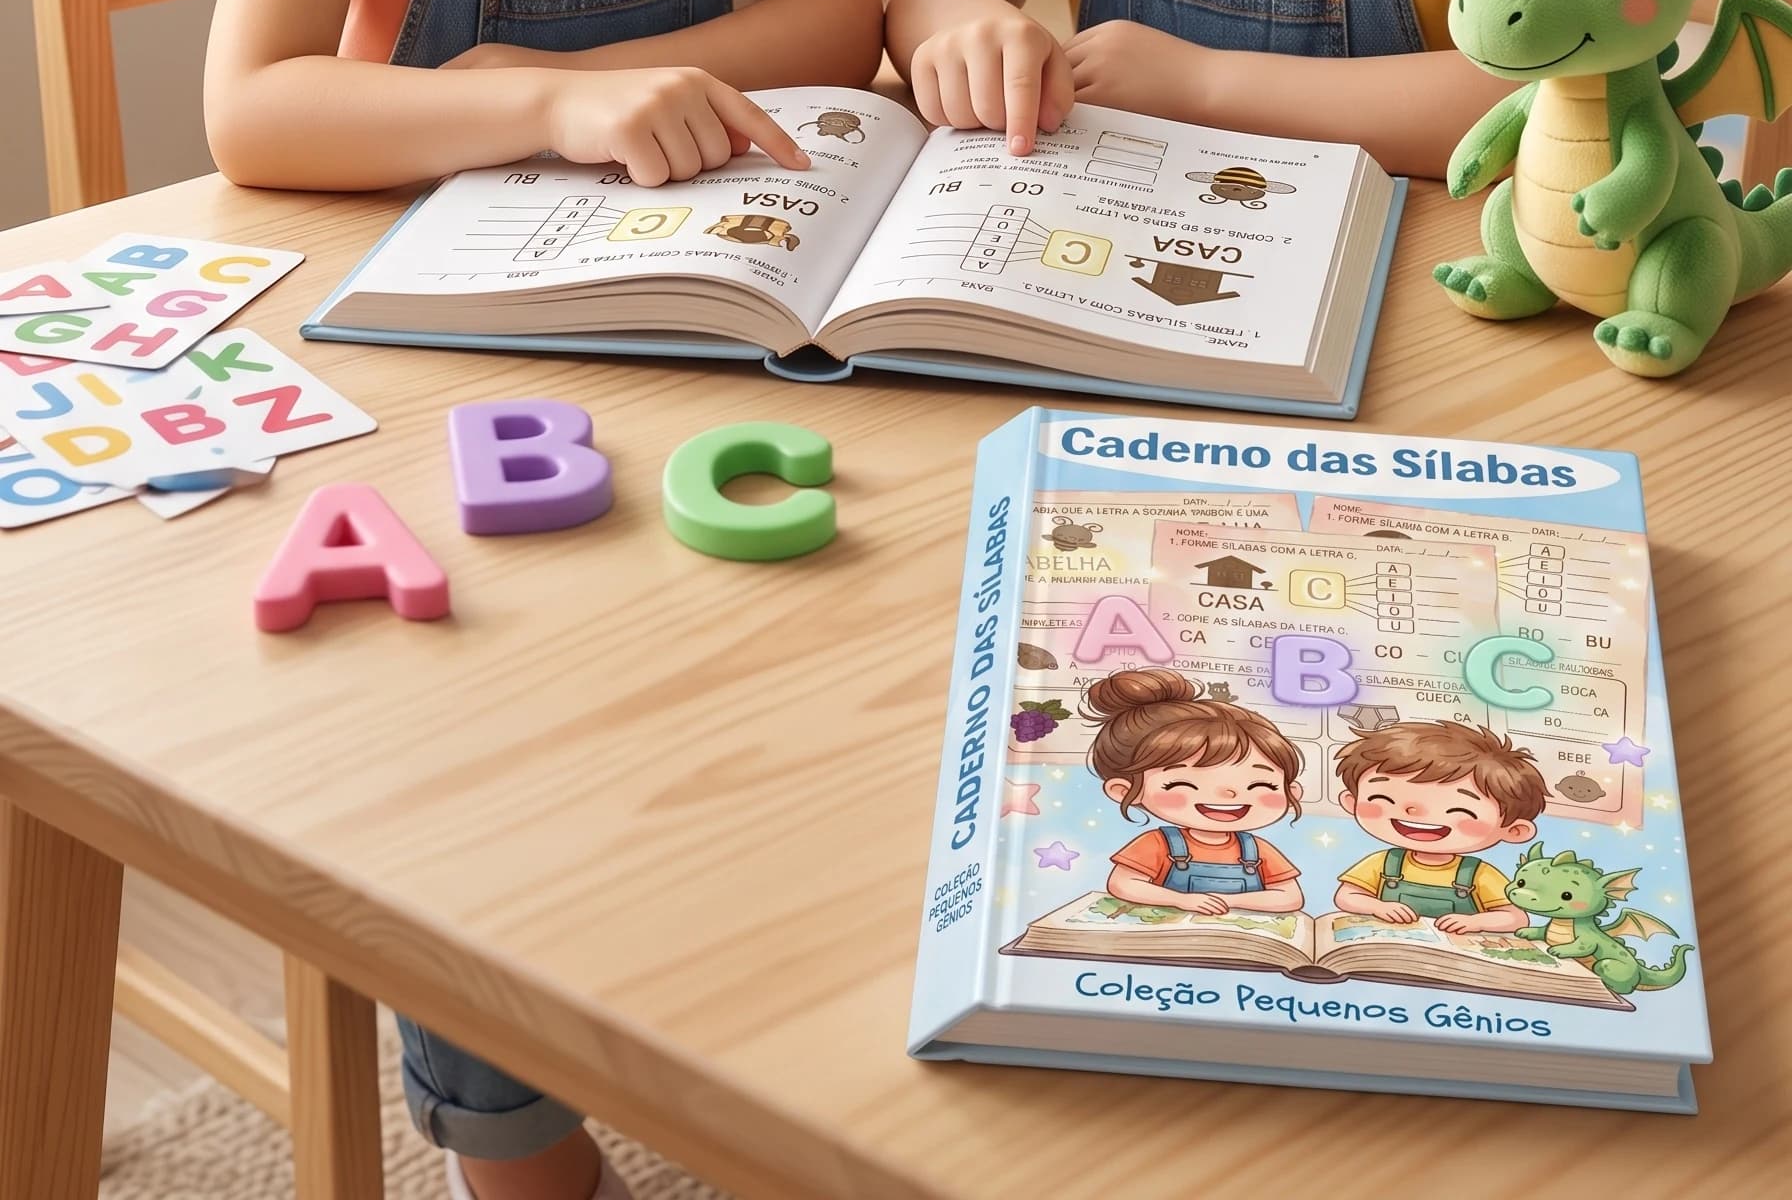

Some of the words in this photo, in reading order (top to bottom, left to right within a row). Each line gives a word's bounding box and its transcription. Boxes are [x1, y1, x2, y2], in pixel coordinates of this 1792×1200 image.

[503, 173, 540, 184] BU
[928, 181, 962, 195] BU
[1010, 181, 1044, 196] CO
[741, 192, 819, 216] CASA
[631, 214, 668, 235] C
[106, 245, 189, 269] B
[1061, 241, 1091, 265] C
[1152, 235, 1242, 264] CASA
[199, 256, 272, 284] C
[978, 261, 989, 269] A
[0, 274, 73, 299] A
[81, 271, 157, 296] A
[145, 290, 228, 318] G
[15, 313, 93, 344] G
[90, 323, 179, 357] H
[186, 342, 274, 382] K
[16, 382, 74, 420] J
[140, 403, 227, 445] B
[42, 425, 132, 467] D
[1061, 426, 1271, 469] Caderno
[1287, 443, 1378, 477] das
[1392, 448, 1578, 488] Sílabas
[448, 398, 614, 537] B
[662, 421, 837, 562] C
[1132, 508, 1142, 517] A
[1338, 514, 1376, 526] FORME
[1425, 524, 1450, 536] COM
[1452, 527, 1462, 537] A
[1464, 529, 1500, 541] LETRA
[1502, 533, 1512, 543] B.
[254, 483, 450, 633] A
[1270, 545, 1296, 557] COM
[1298, 548, 1308, 558] A
[1309, 548, 1344, 560] LETRA
[1541, 546, 1551, 556] A
[1387, 564, 1398, 574] A
[1540, 560, 1549, 570] E
[1306, 577, 1334, 602] C
[1388, 578, 1397, 588] E
[1538, 588, 1548, 599] O
[1198, 591, 1266, 612] CASA
[1389, 606, 1400, 616] O
[1538, 603, 1548, 613] U
[1072, 594, 1176, 664] A
[1162, 612, 1174, 622] 2.
[1177, 613, 1210, 625] COPIE
[1213, 616, 1229, 627] AS
[1231, 616, 1277, 630] SÍLABAS
[1280, 620, 1296, 632] DA
[1299, 623, 1336, 635] LETRA
[1390, 620, 1402, 631] U
[1179, 629, 1207, 645] CA
[1249, 635, 1274, 649] CE
[1374, 644, 1404, 660] CO
[1518, 627, 1544, 642] BO
[1586, 635, 1612, 649] BU
[1172, 659, 1235, 672] COMPLETE
[1238, 664, 1254, 673] AS
[1272, 634, 1359, 706] B
[1464, 635, 1555, 710] C
[1416, 691, 1462, 704] CUECA
[1561, 685, 1598, 698] BOCA
[1453, 712, 1472, 723] CA
[1544, 716, 1562, 728] BO
[1593, 707, 1610, 718] CA
[951, 687, 991, 851] CADERNO
[971, 614, 999, 683] DAS
[929, 878, 982, 922] PEQUENOS
[1075, 971, 1221, 1011] Coleção
[1236, 984, 1410, 1024] Pequenos
[1424, 1002, 1553, 1037] Gênios
